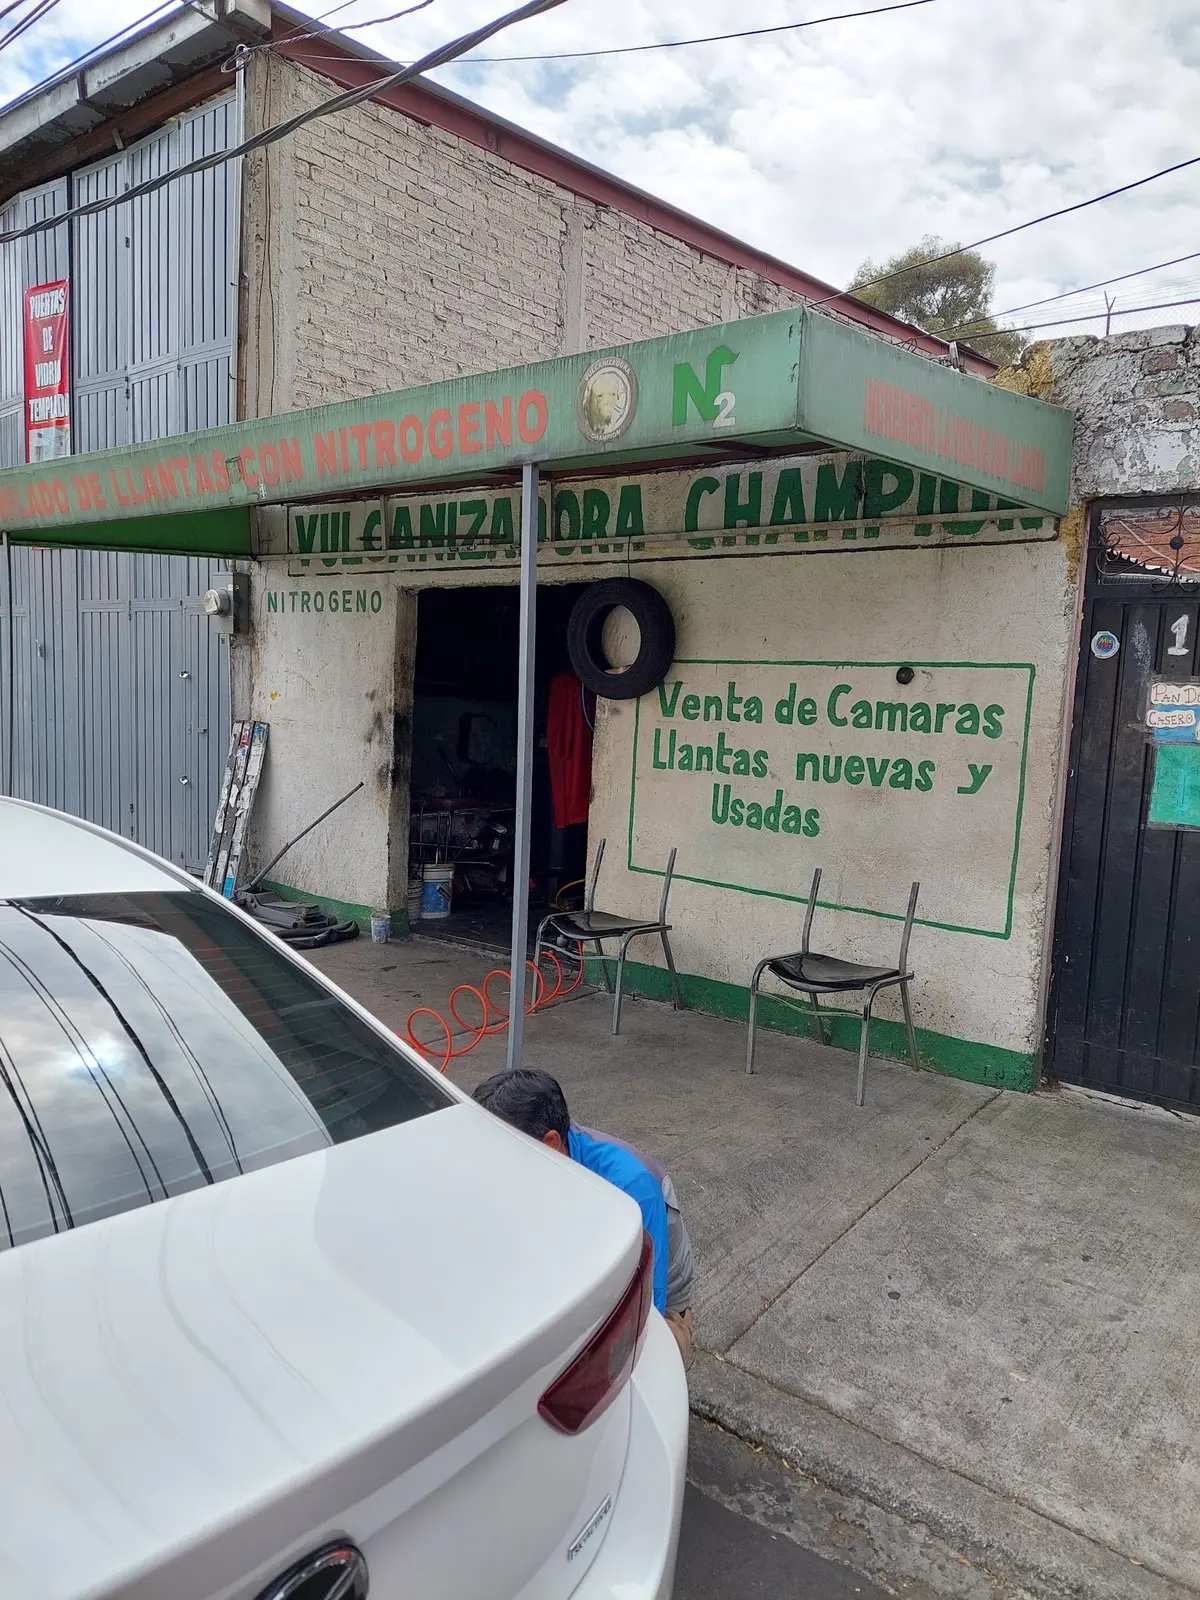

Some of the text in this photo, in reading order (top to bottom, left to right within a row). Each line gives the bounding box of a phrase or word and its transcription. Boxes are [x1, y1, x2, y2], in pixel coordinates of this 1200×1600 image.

[30, 288, 65, 320] PUERTAS
[43, 326, 53, 351] DE
[585, 359, 631, 380] VULCANIZADORA
[72, 473, 107, 511] DE
[110, 449, 231, 507] LLANTAS
[239, 437, 303, 489] CON
[314, 389, 548, 478] NITROGENO
[590, 430, 621, 440] CHAMPION
[267, 590, 382, 613] NITROGENO
[1167, 613, 1190, 656] 1
[657, 681, 1005, 739] Venta de Camaras
[1149, 711, 1194, 725] CASERO
[652, 728, 993, 794] Llantas nuevas y
[711, 783, 820, 837] Usadas
